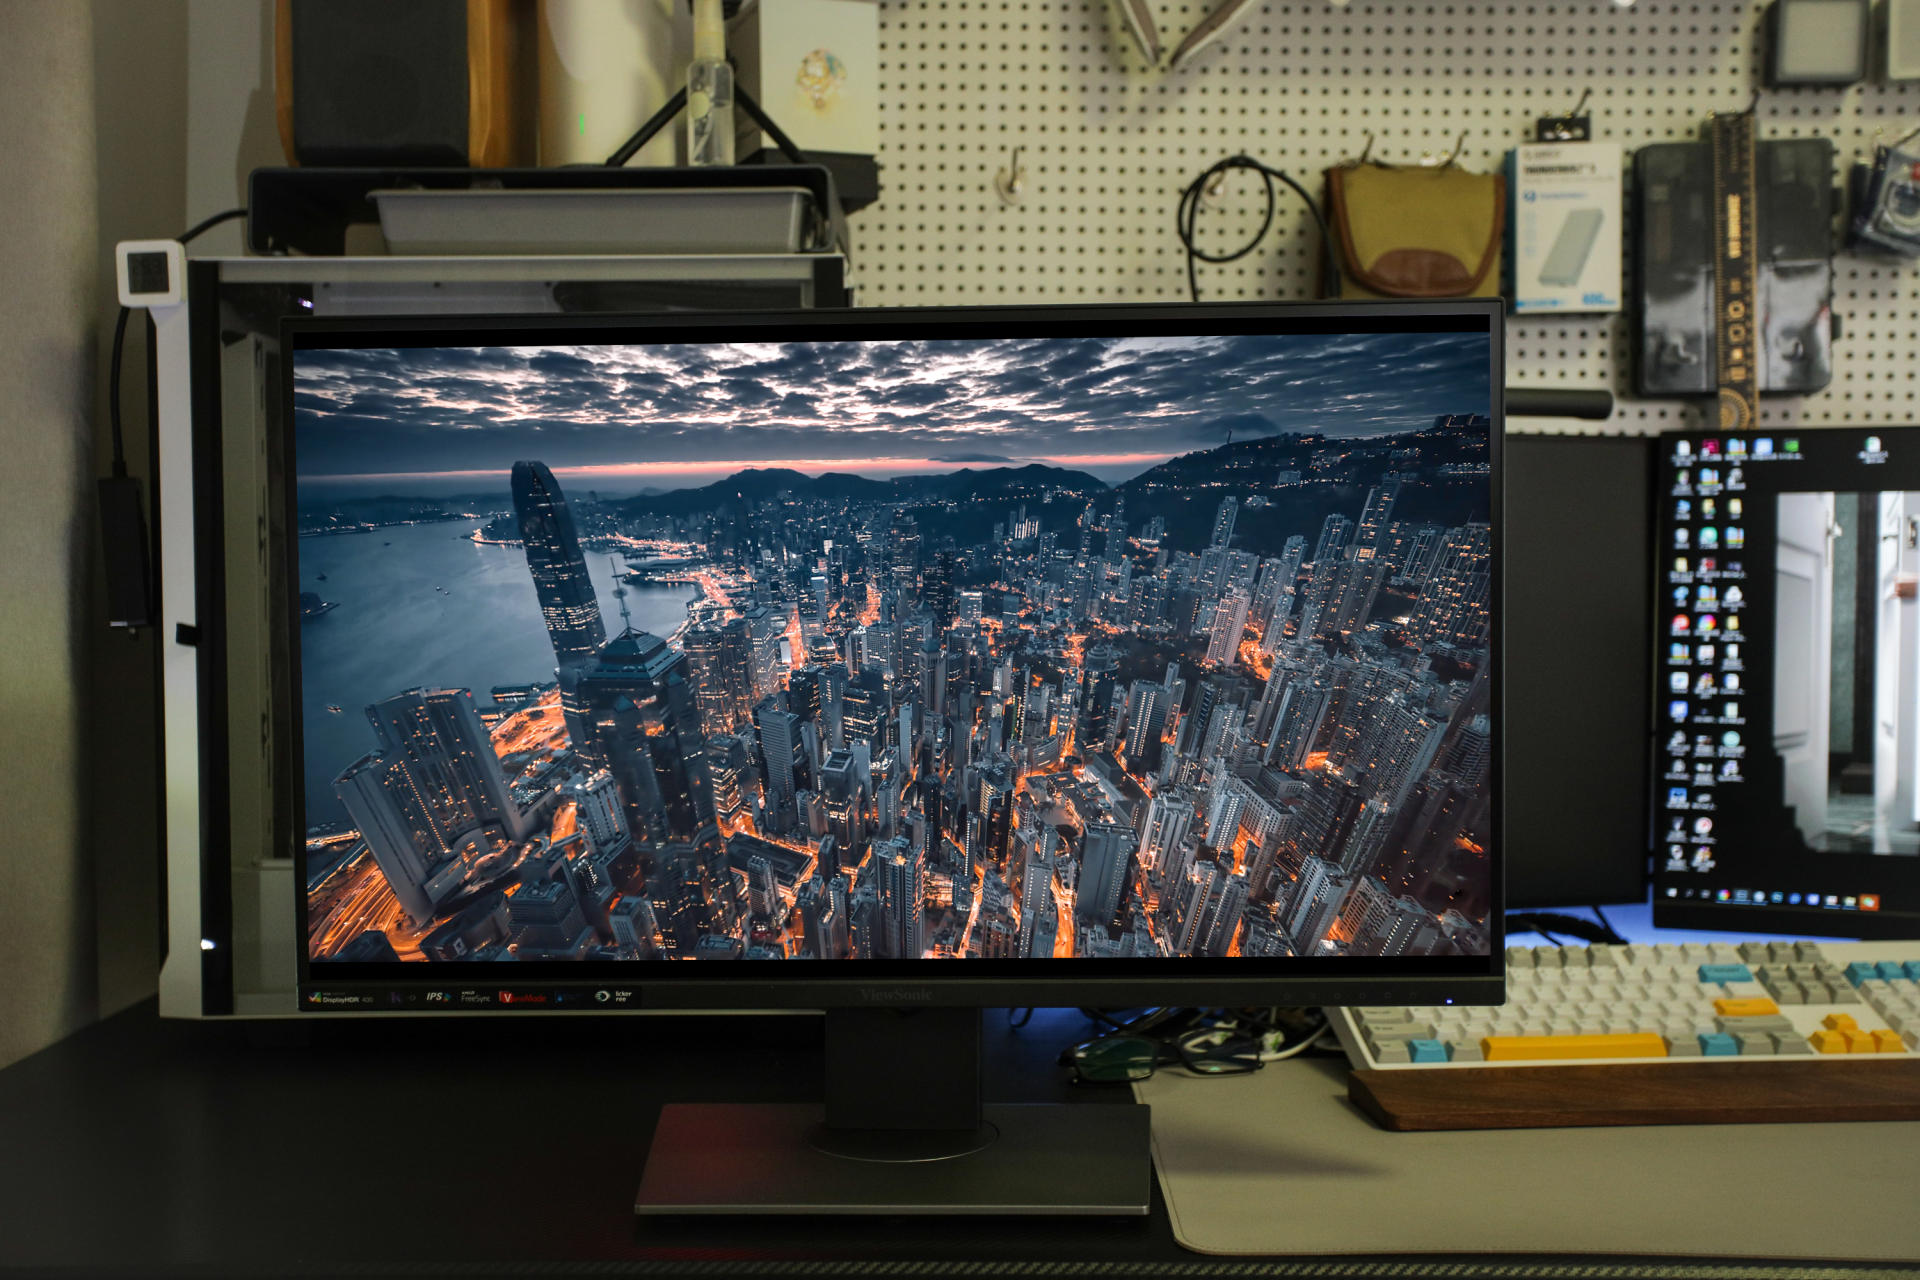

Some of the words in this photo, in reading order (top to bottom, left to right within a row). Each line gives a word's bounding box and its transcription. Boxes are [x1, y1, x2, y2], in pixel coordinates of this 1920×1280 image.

[426, 992, 443, 1001] IPS
[860, 988, 933, 1001] ViewSonic
[322, 996, 359, 1004] DisplayHDR
[461, 995, 491, 1005] FreeSync
